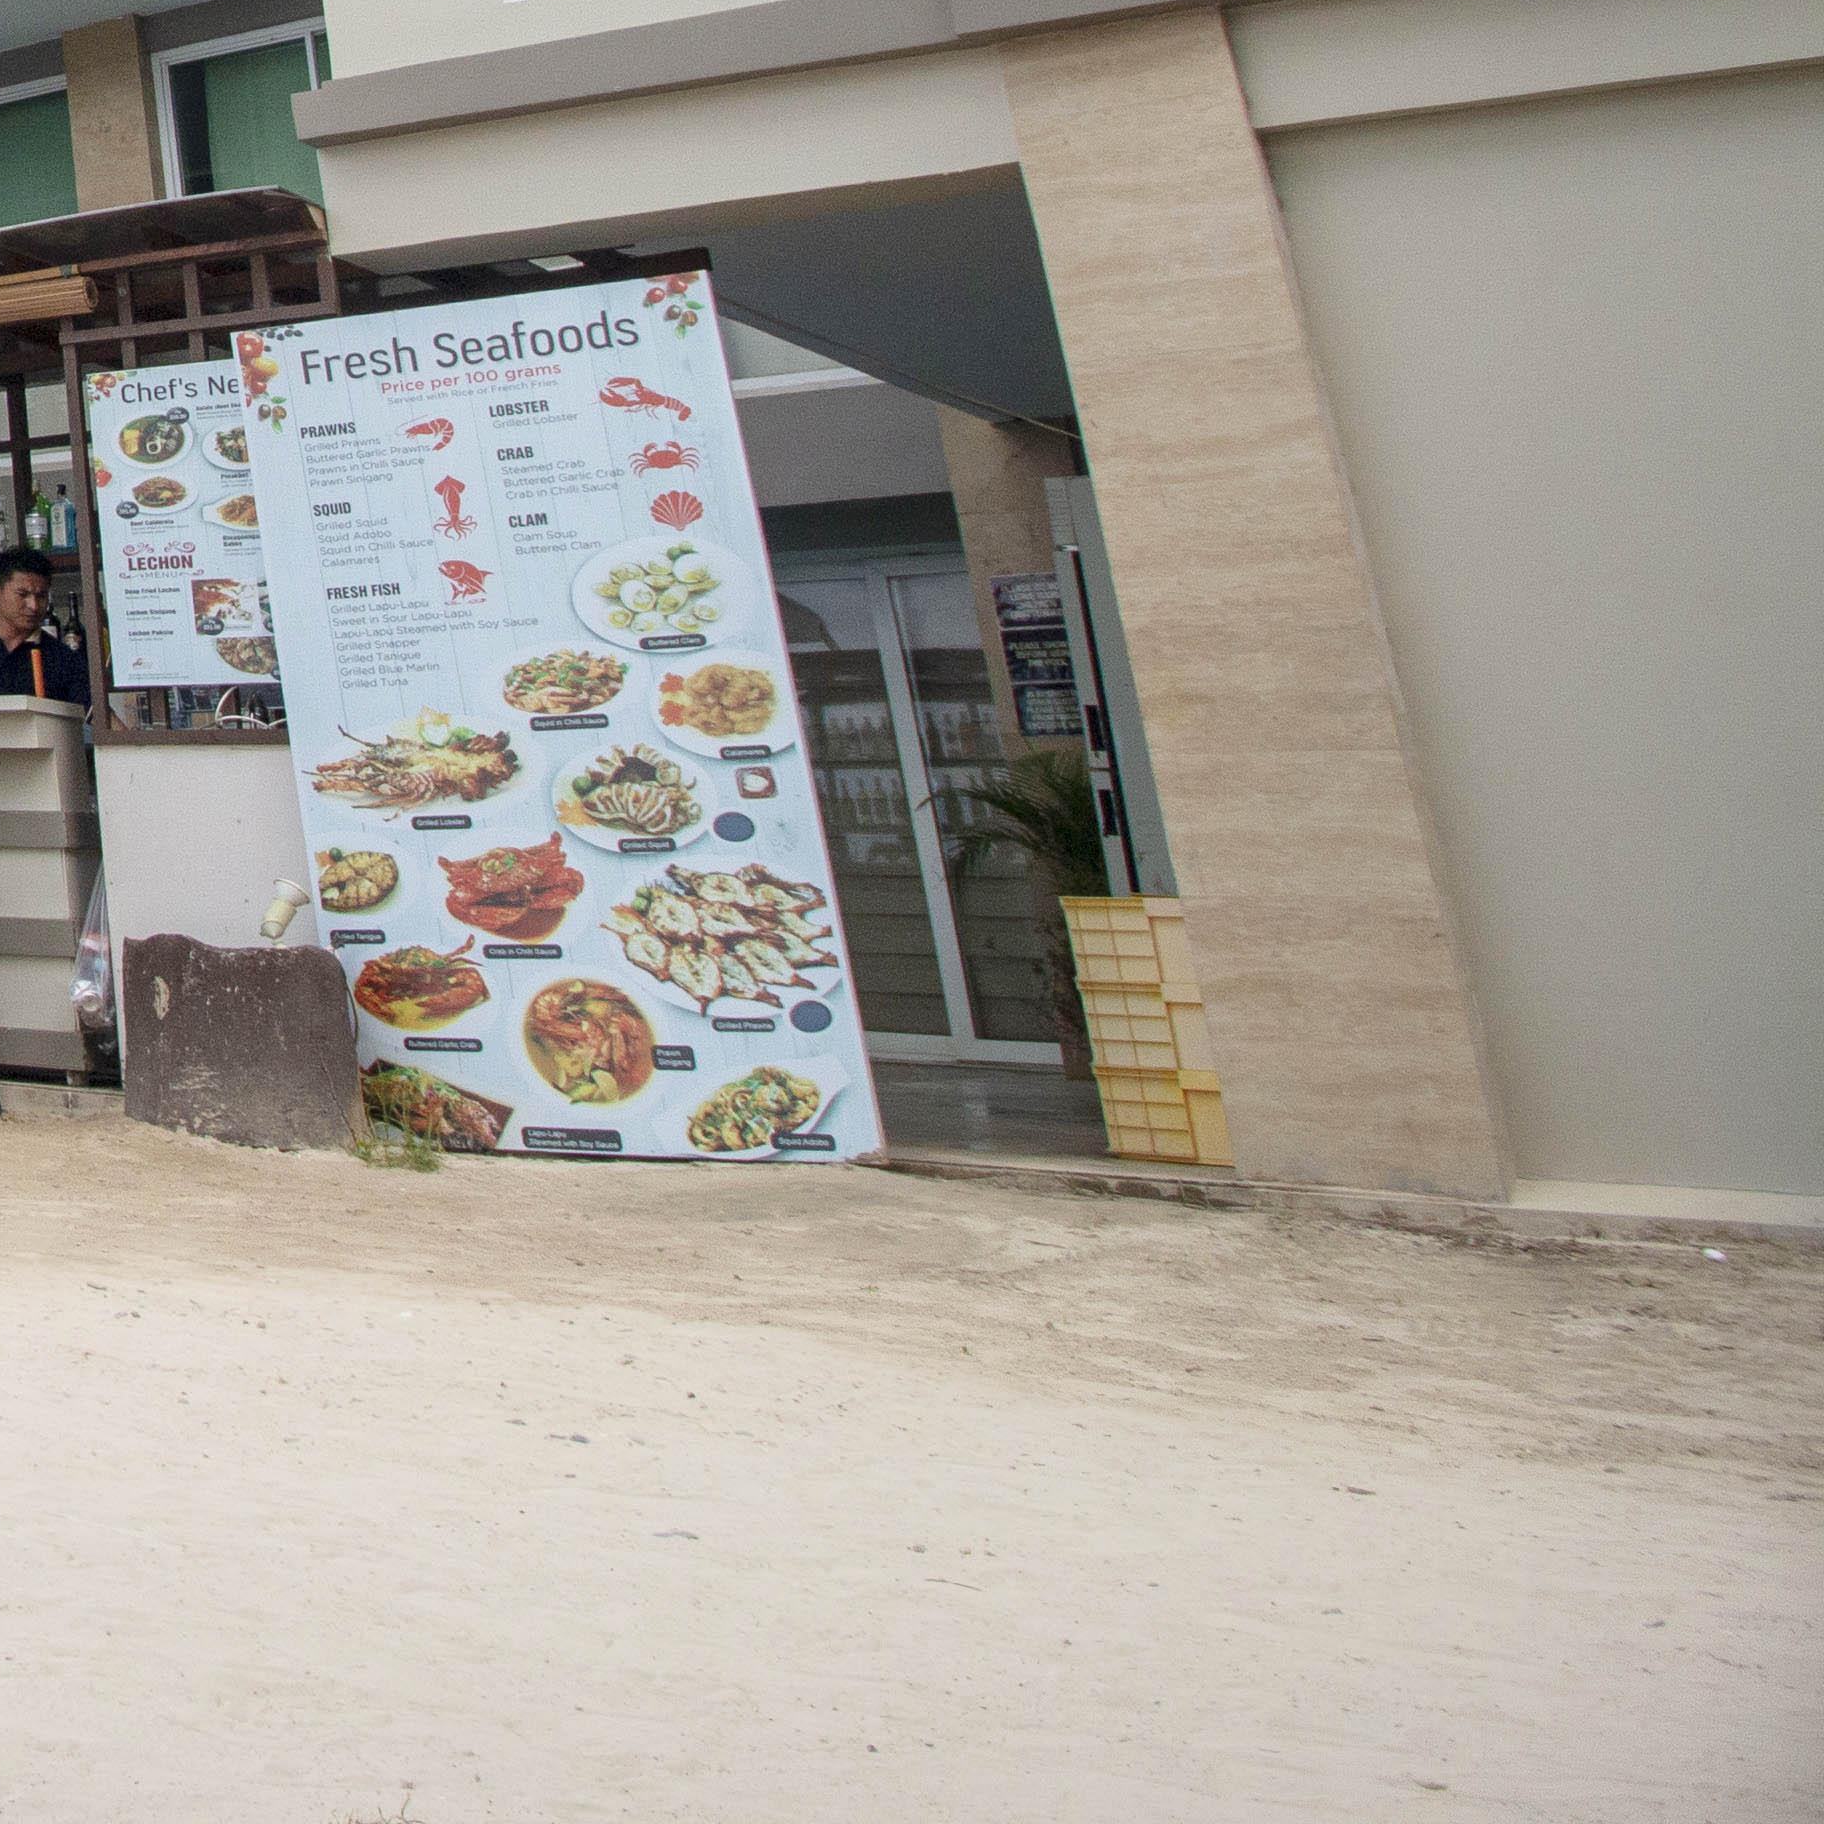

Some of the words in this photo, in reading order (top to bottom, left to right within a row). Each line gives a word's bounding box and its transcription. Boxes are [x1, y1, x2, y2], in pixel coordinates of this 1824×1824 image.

[301, 336, 418, 384] Fresh
[433, 310, 639, 368] Seafoods
[380, 380, 424, 395] Price
[431, 376, 459, 392] per
[465, 371, 498, 385] 100
[504, 363, 562, 382] grams
[121, 377, 198, 404] Chef's
[387, 394, 423, 406] Served
[426, 391, 450, 402] with
[452, 387, 474, 398] Rice
[476, 387, 488, 395] or
[490, 381, 529, 394] French
[531, 378, 559, 389] Fries
[489, 400, 549, 418] LOBSTER
[492, 417, 530, 429] Grilled
[534, 412, 579, 425] Lobster
[300, 422, 356, 439] PRAWNS
[305, 441, 339, 453] Grilled
[342, 436, 382, 449] Prawns
[306, 451, 353, 464] Buttered
[356, 447, 387, 460] Garlic
[390, 444, 430, 456] Prawns
[497, 446, 535, 462] CRAB
[308, 464, 347, 476] Prawns
[350, 462, 360, 472] in
[362, 460, 389, 471] Chilli
[391, 457, 425, 467] Sauce
[501, 463, 552, 476] Steamed
[556, 459, 586, 470] Crab
[309, 477, 344, 488] Prawn
[346, 472, 393, 486] Sinigang
[503, 476, 555, 489] Buttered
[558, 472, 592, 484] Garlic
[596, 467, 625, 478] Crab
[505, 489, 534, 501] Crab
[536, 488, 548, 498] in
[550, 484, 579, 496] Chilli
[582, 481, 619, 493] Sauce
[313, 502, 352, 518] SQUID
[315, 520, 352, 532] Grilled
[355, 517, 388, 530] Squid
[508, 513, 549, 529] CLAM
[318, 533, 350, 545] Squid
[353, 529, 392, 541] Adobo
[512, 532, 544, 543] Clam
[546, 529, 577, 542] Soup
[320, 546, 352, 559] Squid
[355, 543, 365, 553] in
[368, 539, 396, 551] Chilli
[398, 537, 434, 548] Sauce
[514, 543, 567, 556] Buttered
[570, 540, 602, 552] Clam
[128, 555, 193, 571] LECHON
[322, 556, 380, 569] Calamares
[144, 570, 179, 579] MENU
[158, 586, 181, 594] Lechon
[326, 585, 368, 600] FRESH
[371, 582, 401, 596] FISH
[330, 603, 366, 615] Grilled
[369, 598, 429, 613] Lapu-Lapu
[332, 616, 366, 628] Sweet
[369, 614, 380, 624] in
[383, 612, 408, 623] Sour
[411, 608, 472, 623] Lapu-Lapu
[334, 626, 393, 640] Lapu-Lapu
[396, 623, 446, 636] Steamed
[450, 620, 475, 631] with
[477, 618, 499, 630] Soy
[502, 616, 538, 627] Sauce
[336, 640, 371, 652] Grilled
[374, 637, 420, 651] Snapper
[648, 638, 679, 648] Buttered
[681, 636, 701, 645] Clam
[338, 653, 373, 665] Grilled
[376, 650, 421, 664] Tanigue
[340, 665, 376, 677] Grilled
[378, 663, 403, 675] Blue
[405, 660, 440, 672] Marlin
[342, 677, 377, 689] Grilled
[380, 676, 408, 687] Tuna
[533, 718, 555, 729] Squid
[584, 716, 607, 725] Sauce
[416, 817, 439, 827] Grilled
[440, 817, 466, 826] Lobster
[489, 947, 506, 956] Crab
[535, 947, 558, 957] Sauce
